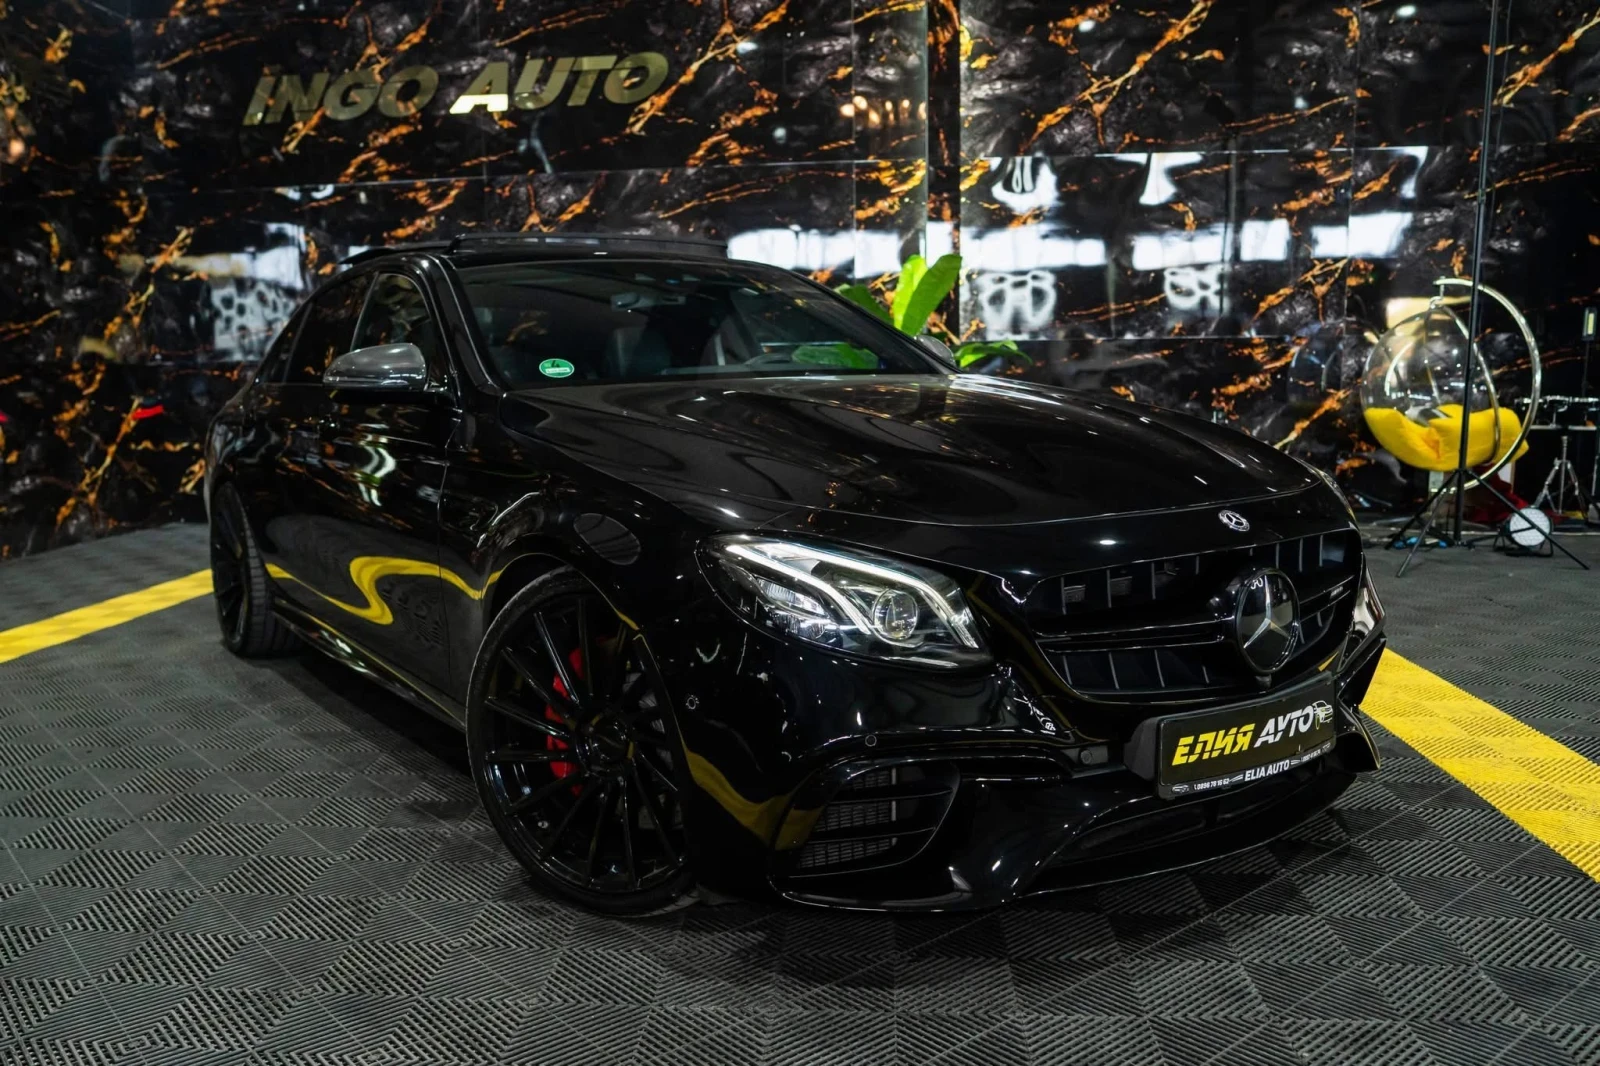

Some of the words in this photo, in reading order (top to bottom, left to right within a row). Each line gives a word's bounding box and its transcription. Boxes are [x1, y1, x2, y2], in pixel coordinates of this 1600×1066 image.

[243, 65, 439, 126] INGO
[449, 52, 669, 114] AUTO
[1172, 723, 1256, 766] ЕЛИЯ
[1254, 706, 1314, 748] АУТО
[1244, 767, 1265, 781] ELIA
[1266, 760, 1290, 776] AUTO
